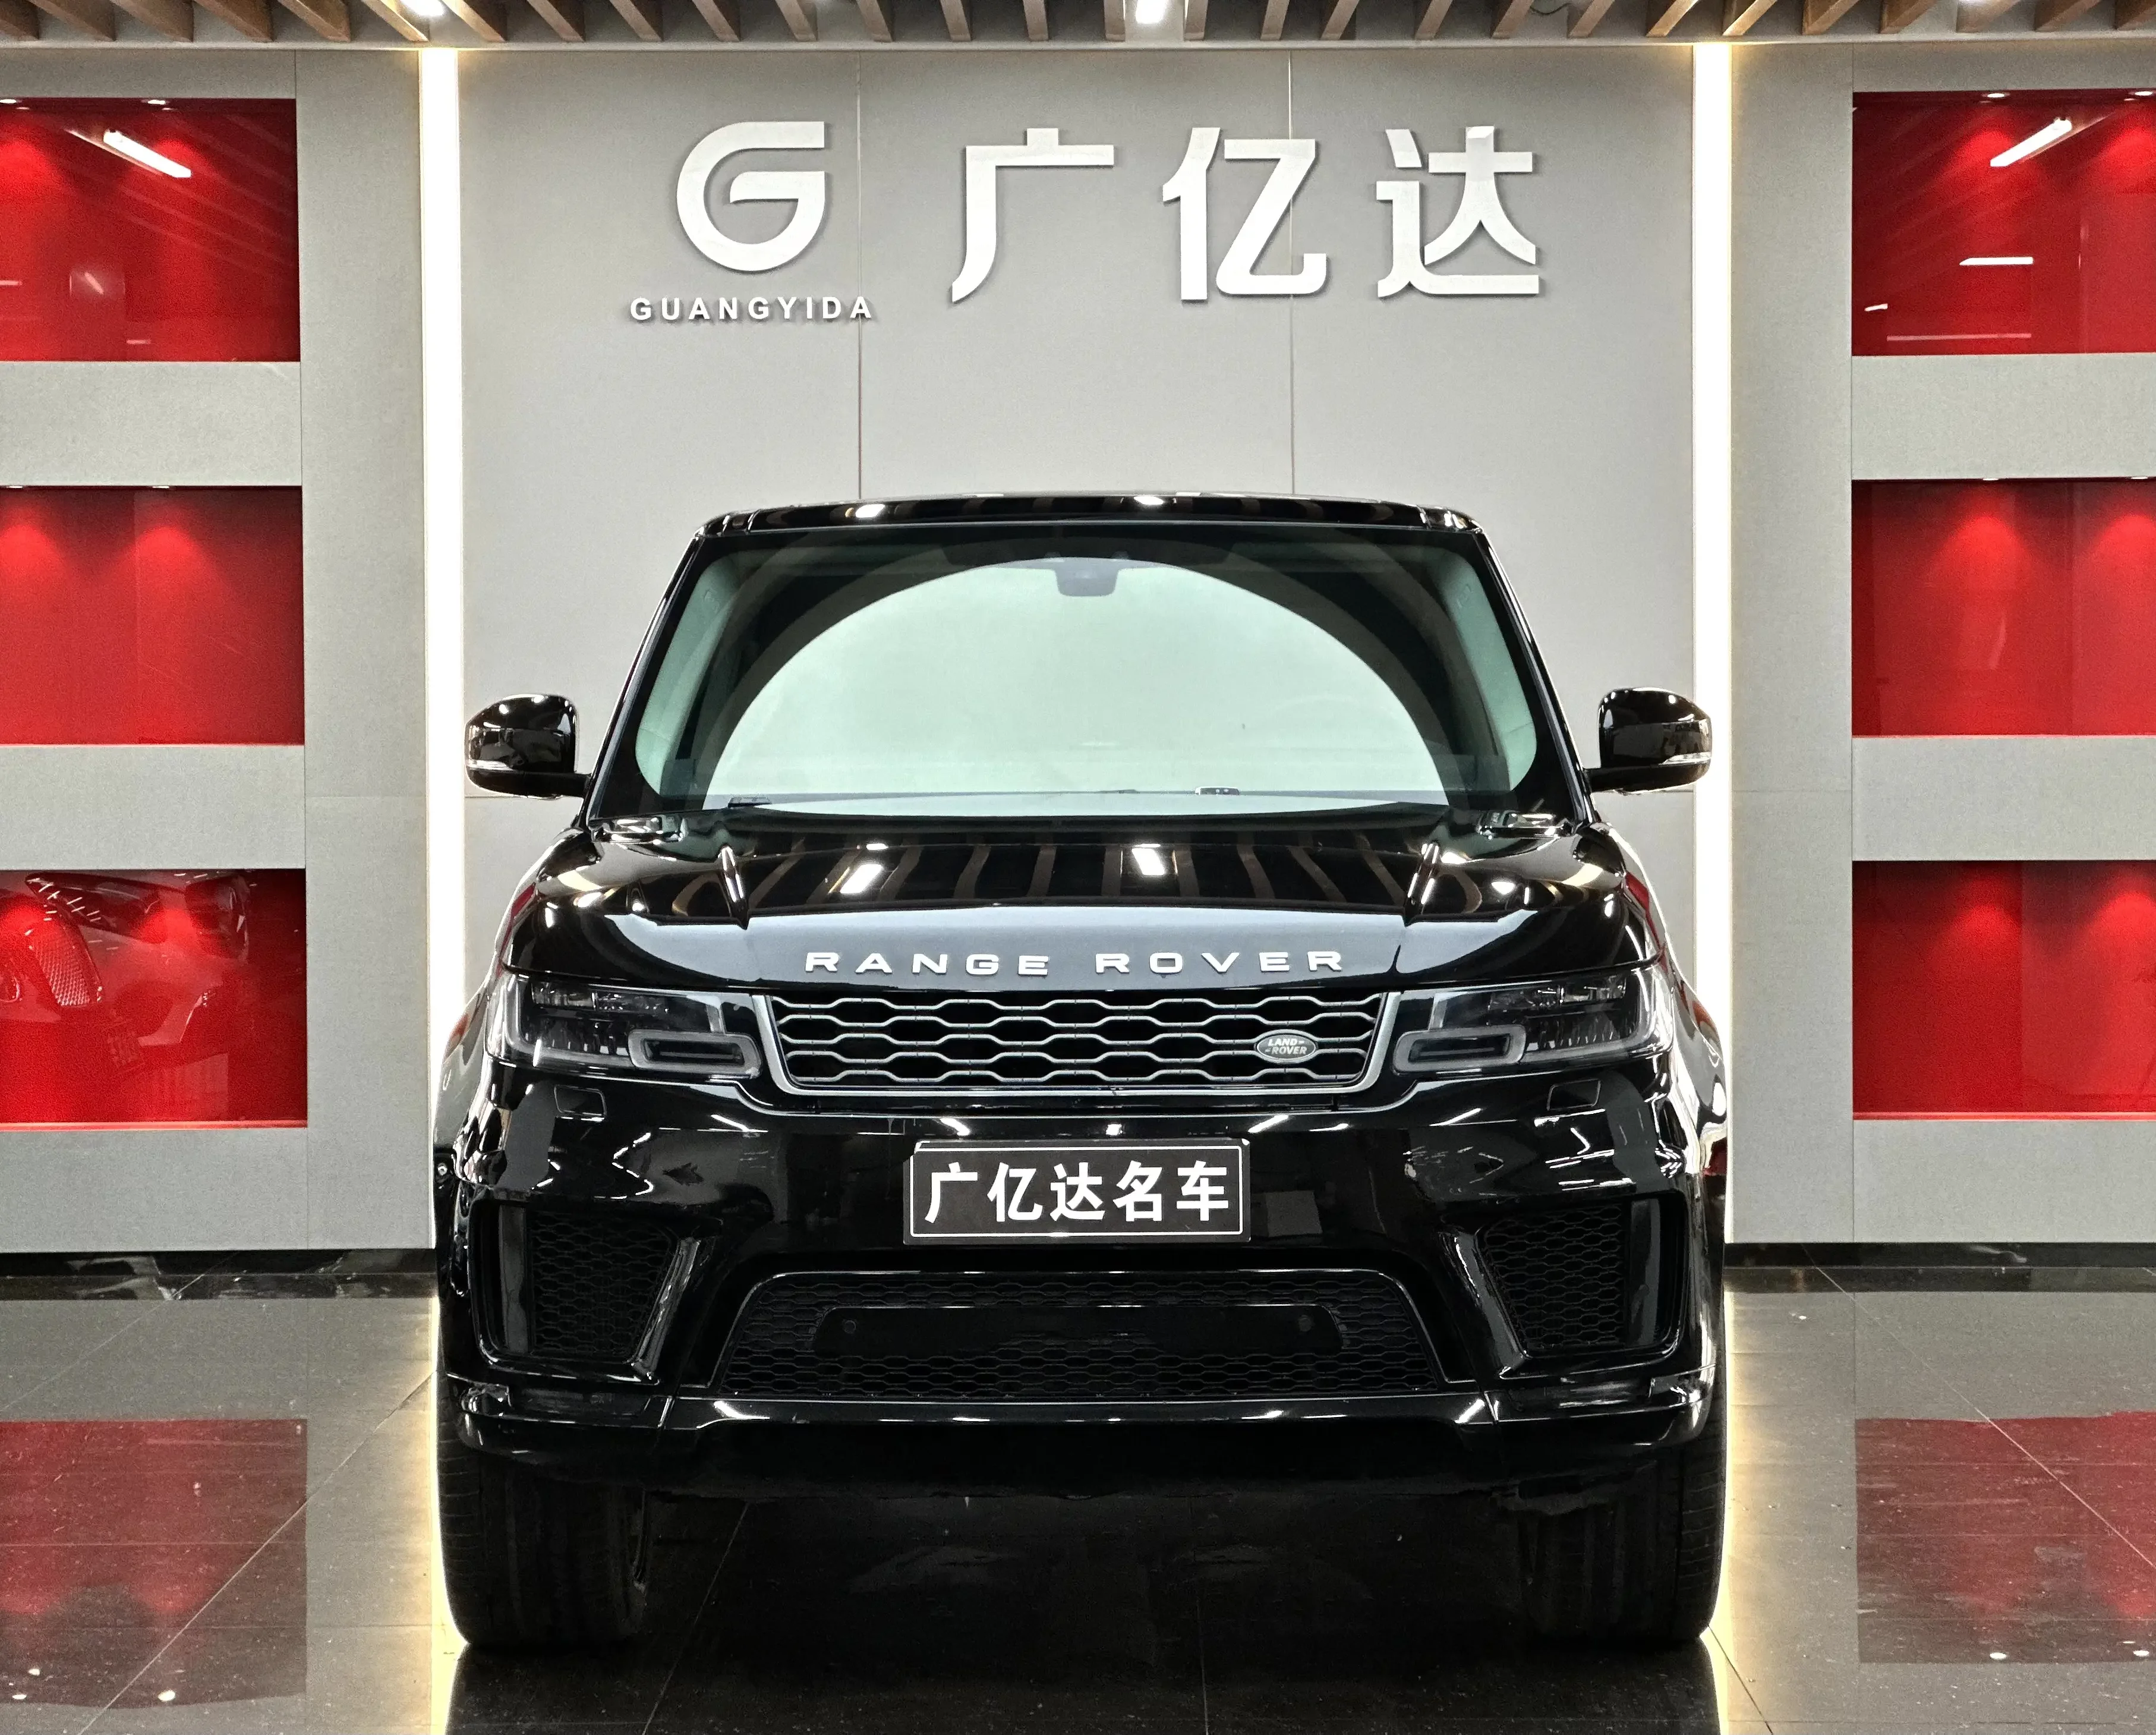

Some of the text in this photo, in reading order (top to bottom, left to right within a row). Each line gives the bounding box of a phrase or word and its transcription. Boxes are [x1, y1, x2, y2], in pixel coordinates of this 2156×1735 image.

[951, 126, 1539, 304] 广亿达
[630, 296, 872, 320] GUANGYIDA
[804, 950, 1342, 977] RANGE ROVER
[925, 1160, 1229, 1223] 广亿达名车
